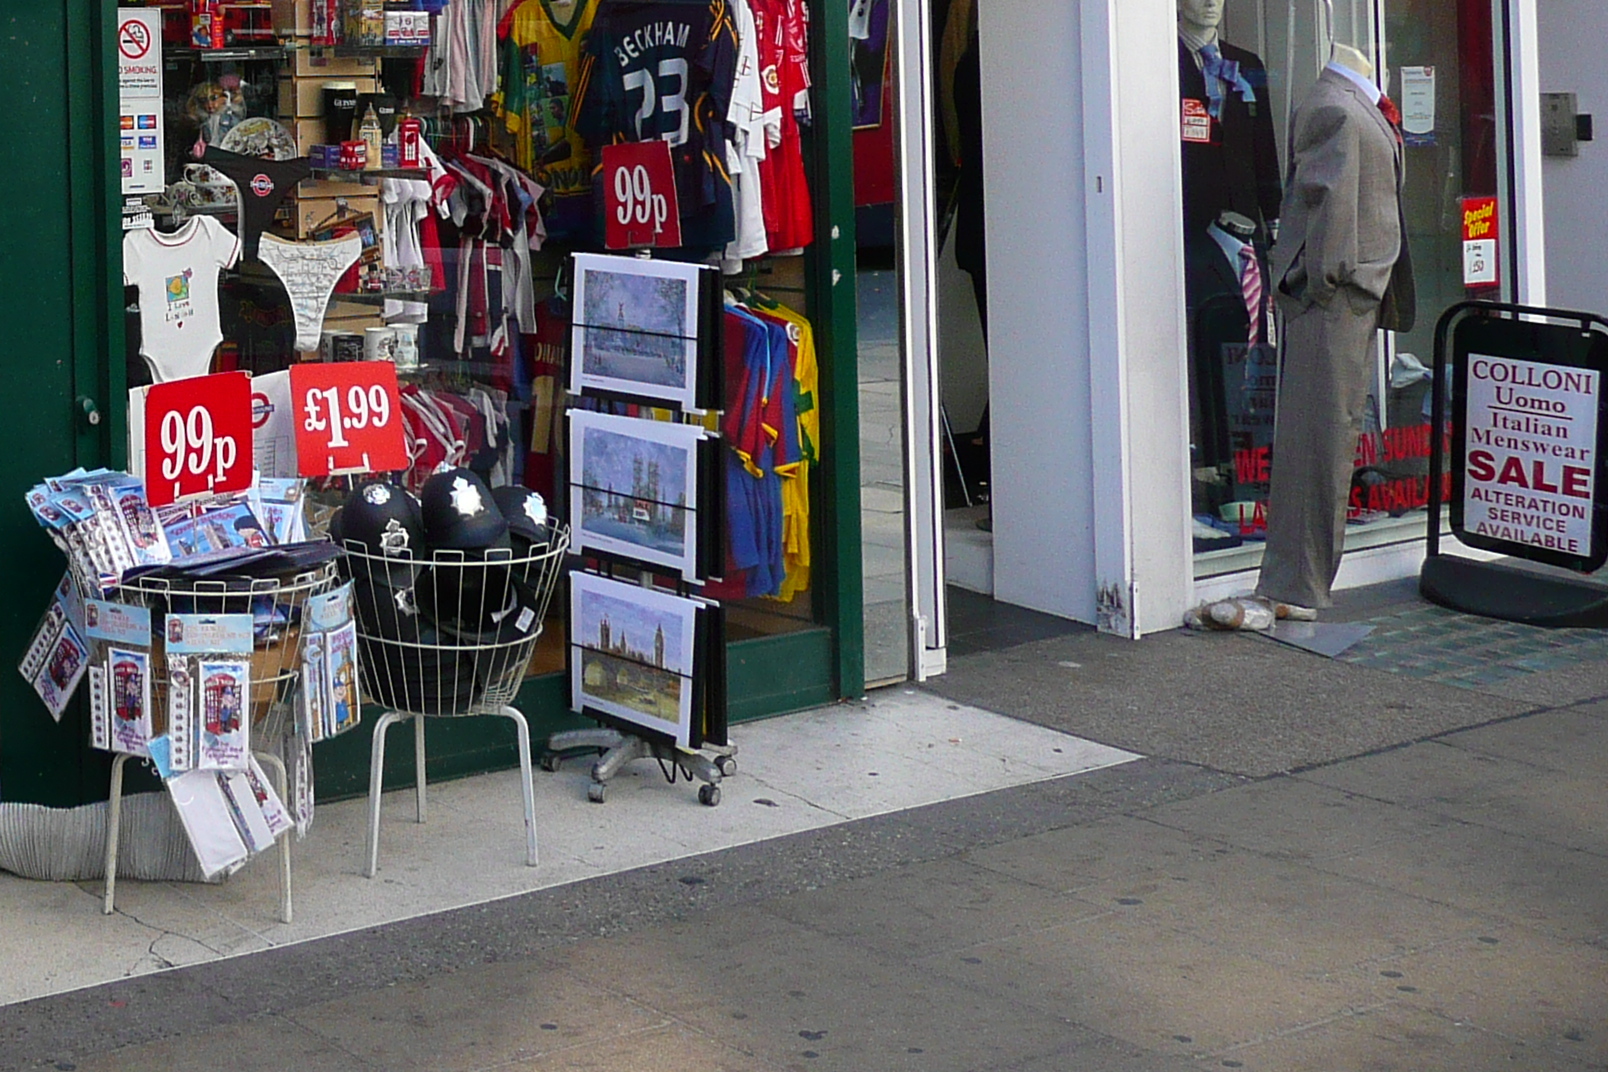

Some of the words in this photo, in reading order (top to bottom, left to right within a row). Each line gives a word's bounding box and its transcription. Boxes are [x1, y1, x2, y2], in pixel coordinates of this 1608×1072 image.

[614, 22, 690, 67] BECKHAM
[623, 57, 689, 148] 23
[613, 165, 667, 234] 99p
[1464, 200, 1494, 226] Special
[1468, 219, 1491, 239] Offer
[1472, 360, 1592, 394] COLLONI
[304, 384, 390, 448] £1.99
[1495, 386, 1566, 414] Uomo
[1492, 412, 1568, 439] Italian
[161, 405, 237, 482] 99p
[1471, 428, 1590, 461] Menswear
[1235, 446, 1270, 484] WE
[1467, 449, 1591, 499] SALE
[1471, 487, 1585, 519] ALTERATION
[1488, 507, 1566, 533] SERVICE
[1476, 521, 1578, 553] AVAILABLE
